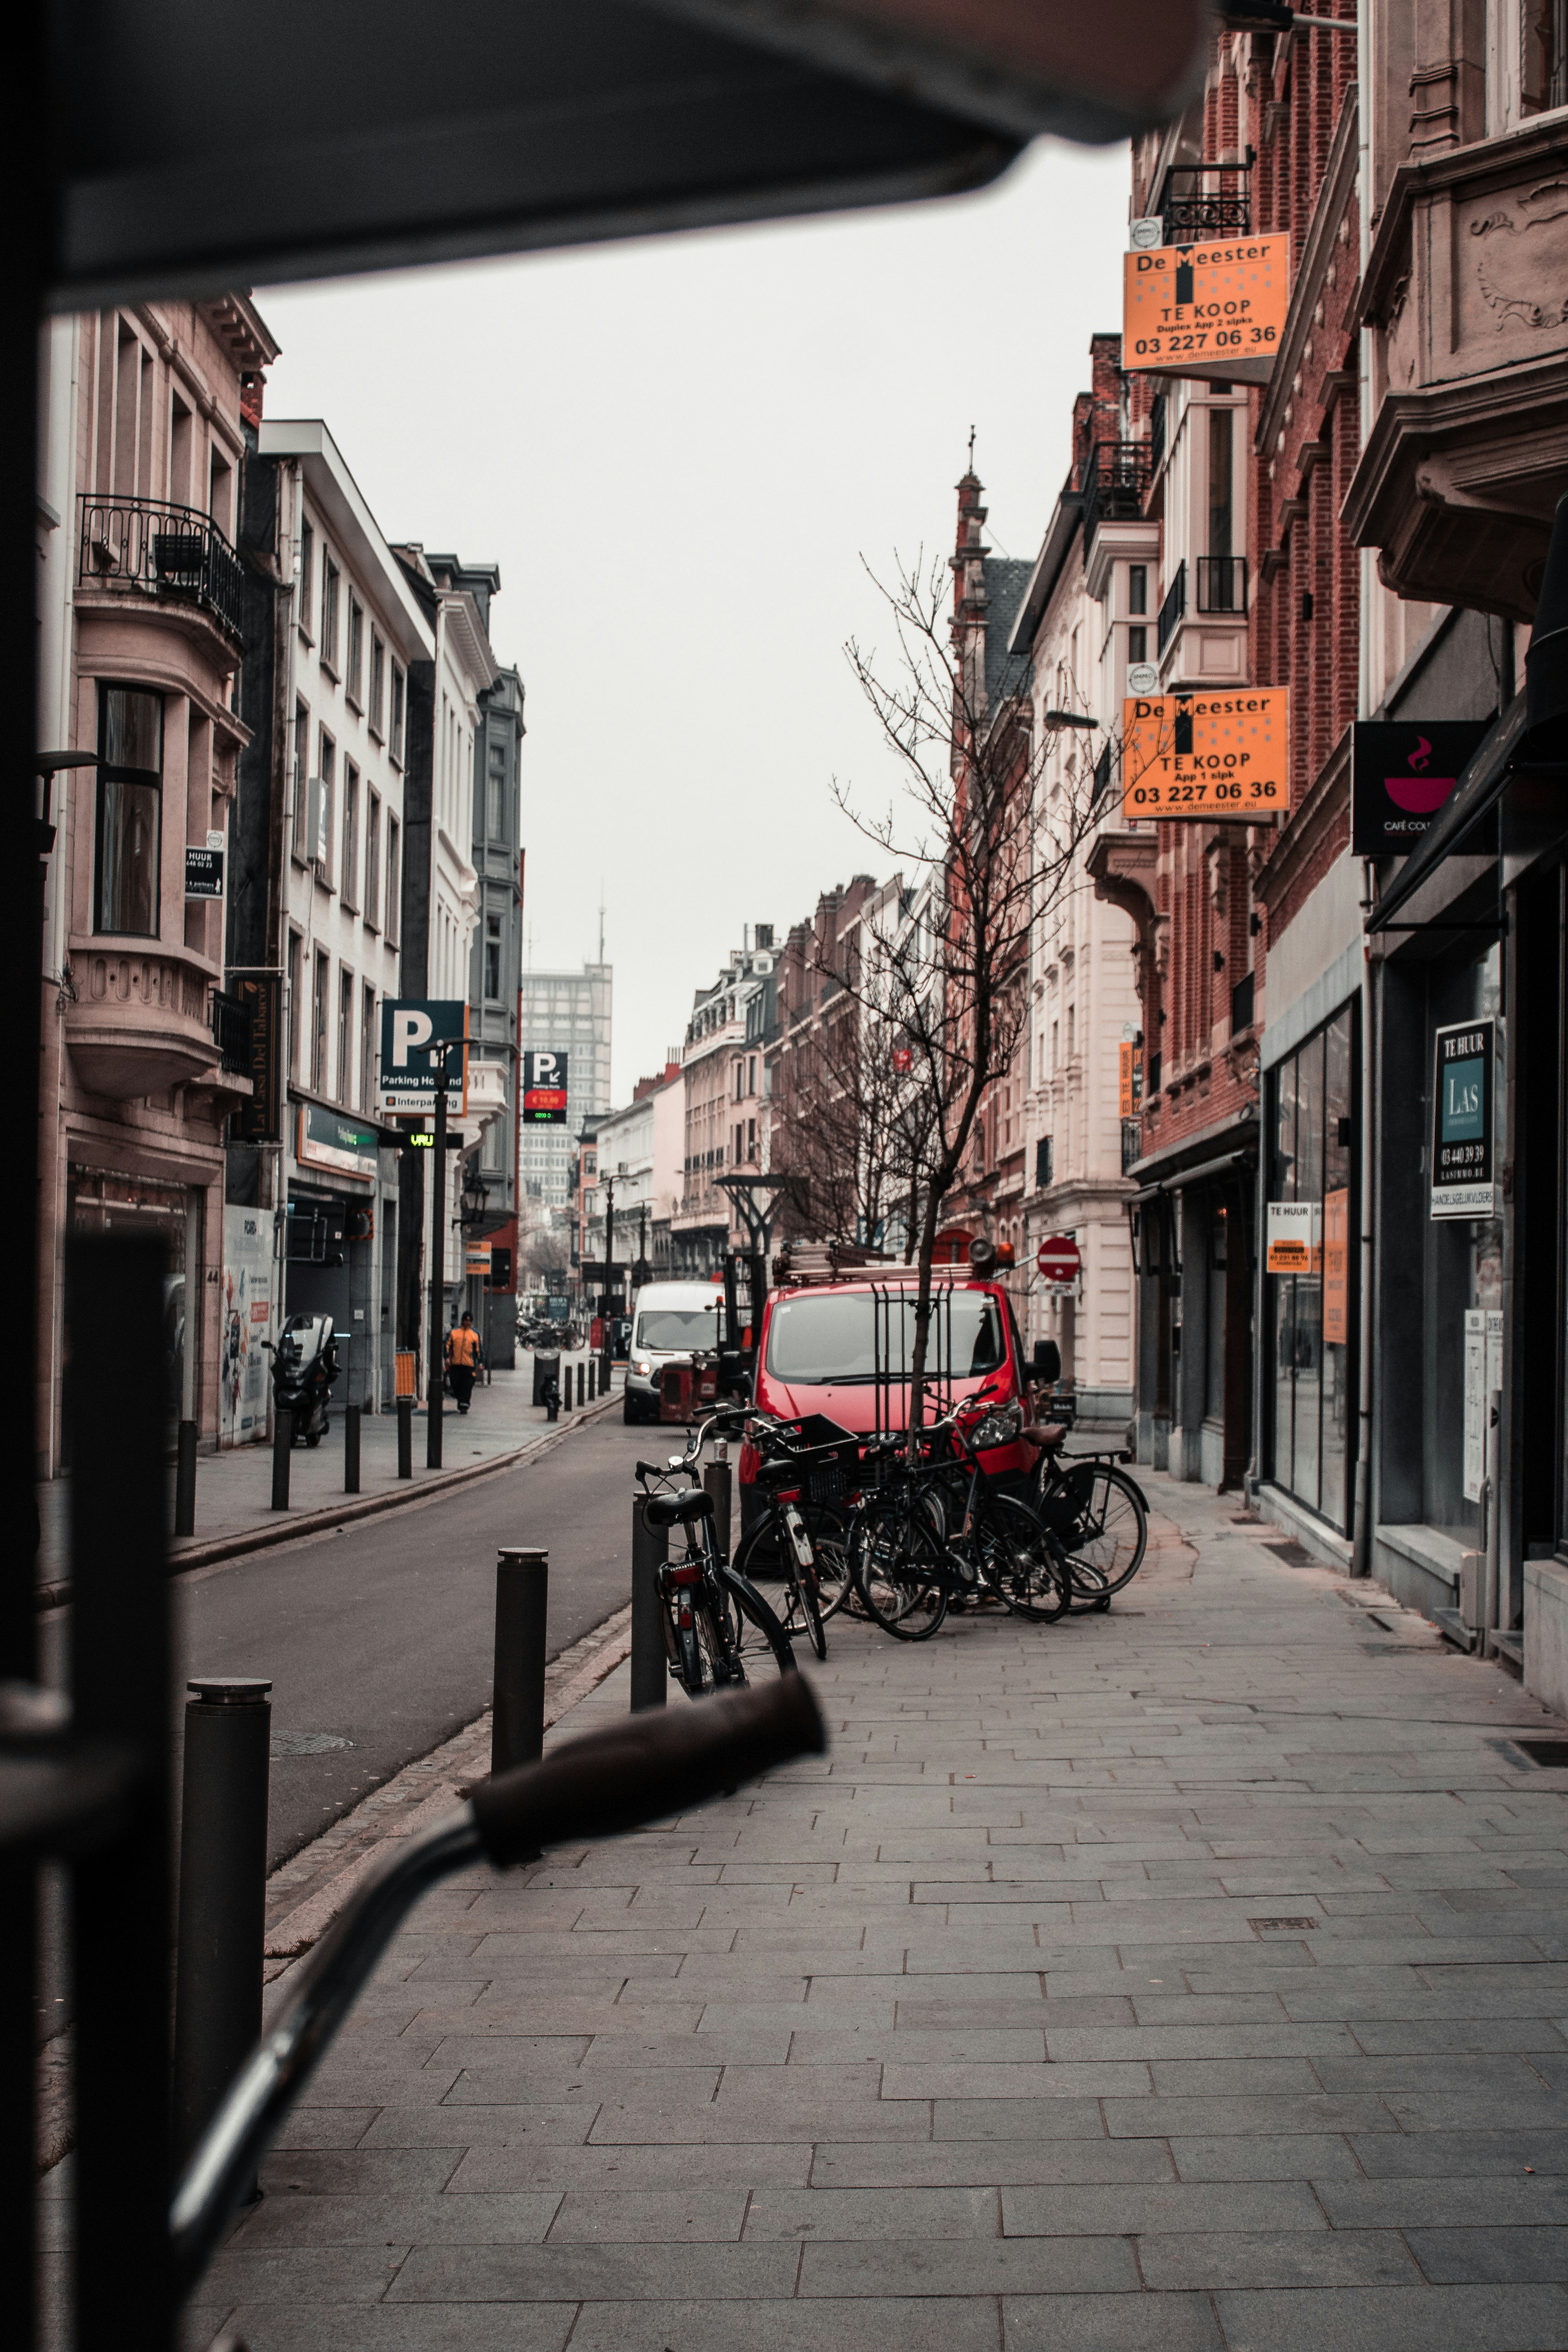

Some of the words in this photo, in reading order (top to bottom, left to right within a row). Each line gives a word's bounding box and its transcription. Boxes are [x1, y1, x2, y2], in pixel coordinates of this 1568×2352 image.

[1137, 256, 1166, 272] De
[1177, 245, 1271, 268] Meester
[1161, 307, 1185, 322] TE
[1194, 299, 1251, 318] KOOP
[1157, 323, 1191, 333] Duplex
[1195, 321, 1214, 329] App
[1226, 317, 1253, 326] slpks
[1136, 338, 1161, 354] 03
[1169, 333, 1208, 352] 227
[1216, 329, 1242, 347] 06
[1250, 326, 1276, 343] 36
[1136, 702, 1164, 718] De
[1177, 698, 1270, 718] Meester
[1161, 758, 1184, 771] TE
[1194, 752, 1251, 769] KOOP
[1175, 773, 1196, 783] App
[1211, 770, 1235, 780] slpk
[1135, 788, 1160, 804] 03
[1169, 785, 1207, 802] 227
[1216, 783, 1242, 800] 06
[1250, 781, 1277, 798] 36
[1384, 819, 1406, 831] CAFÉ
[189, 852, 212, 862] HUUR
[253, 988, 266, 1041] Tabaco
[392, 1010, 433, 1067] P
[1444, 1038, 1456, 1058] TE
[1457, 1032, 1484, 1056] HUUR
[252, 1044, 266, 1069] Del
[534, 1053, 556, 1083] P
[252, 1075, 266, 1108] Casa
[382, 1075, 419, 1088] Parking
[421, 1076, 462, 1086] Hond
[252, 1114, 265, 1132] La
[1441, 1147, 1450, 1166] 03
[1452, 1147, 1465, 1165] 440
[1465, 1145, 1474, 1164] 39
[1475, 1144, 1484, 1163] 39
[1271, 1206, 1282, 1216] TE
[1284, 1206, 1308, 1216] HUUR
[207, 1271, 218, 1283] 44
[621, 1322, 632, 1338] P
